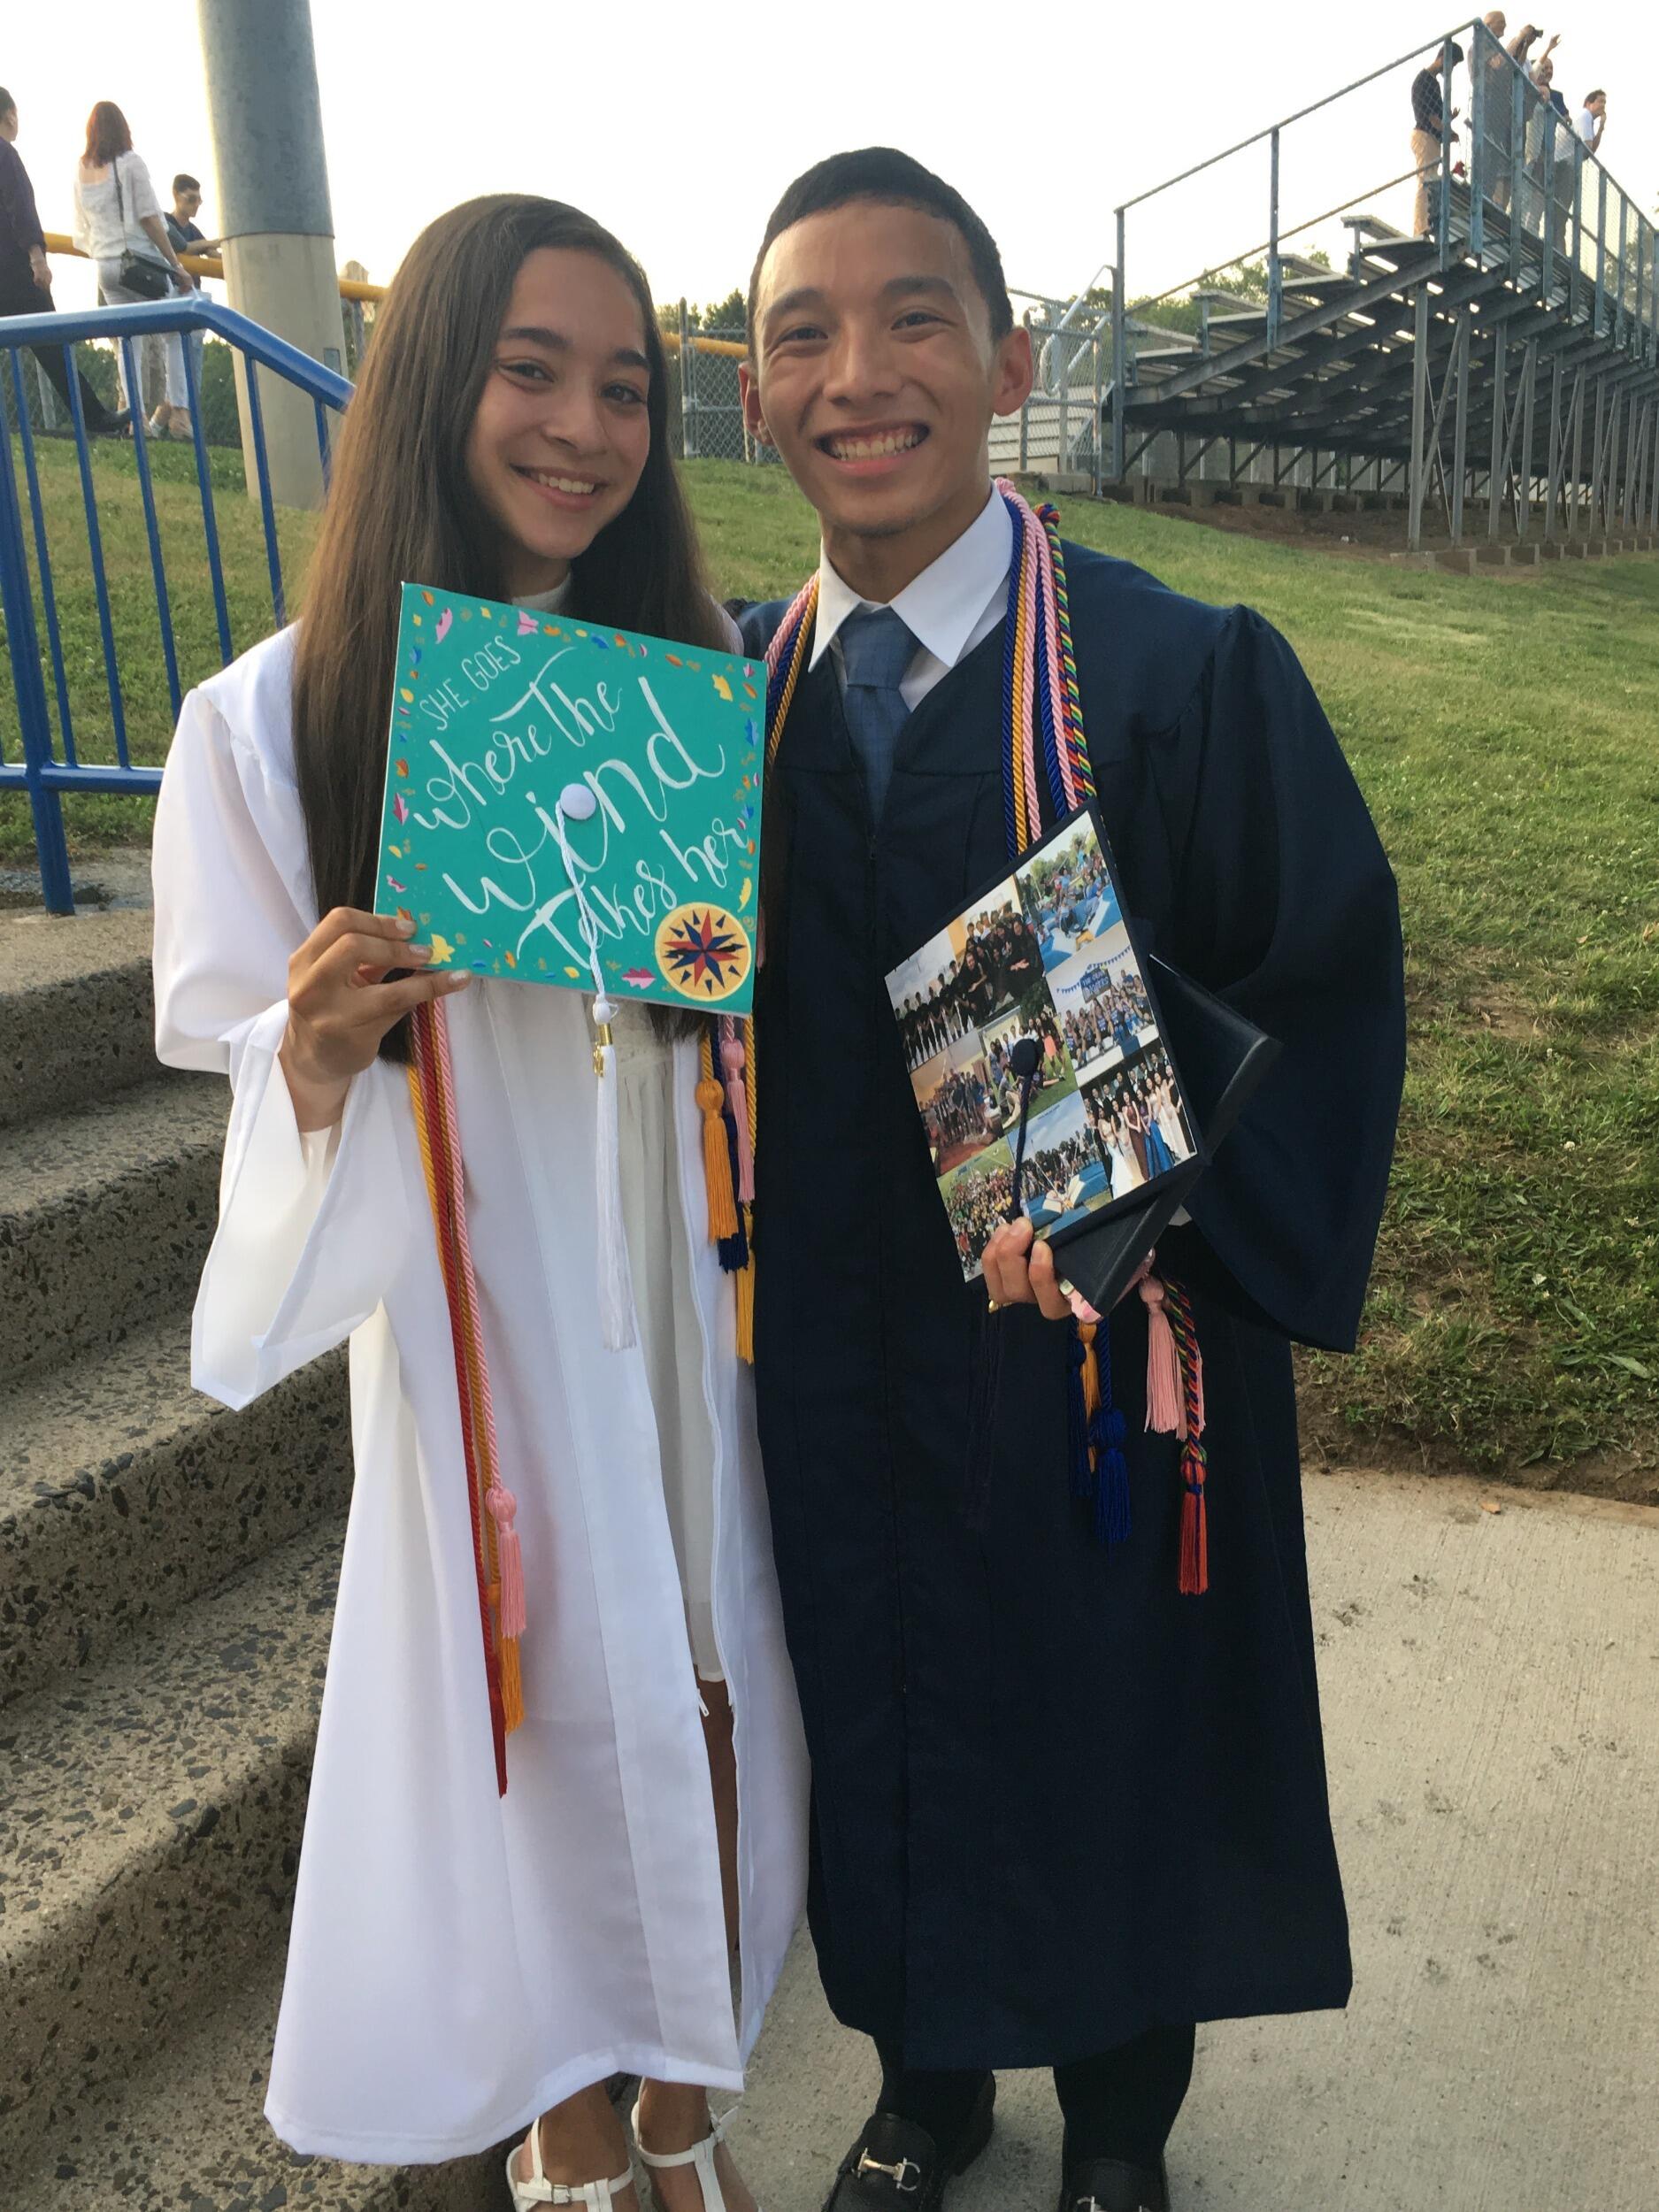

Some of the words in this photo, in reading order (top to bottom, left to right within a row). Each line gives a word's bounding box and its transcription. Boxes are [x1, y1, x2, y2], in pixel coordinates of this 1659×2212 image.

[419, 679, 470, 731] SHE
[462, 635, 521, 692] GOES
[660, 818, 749, 888] her
